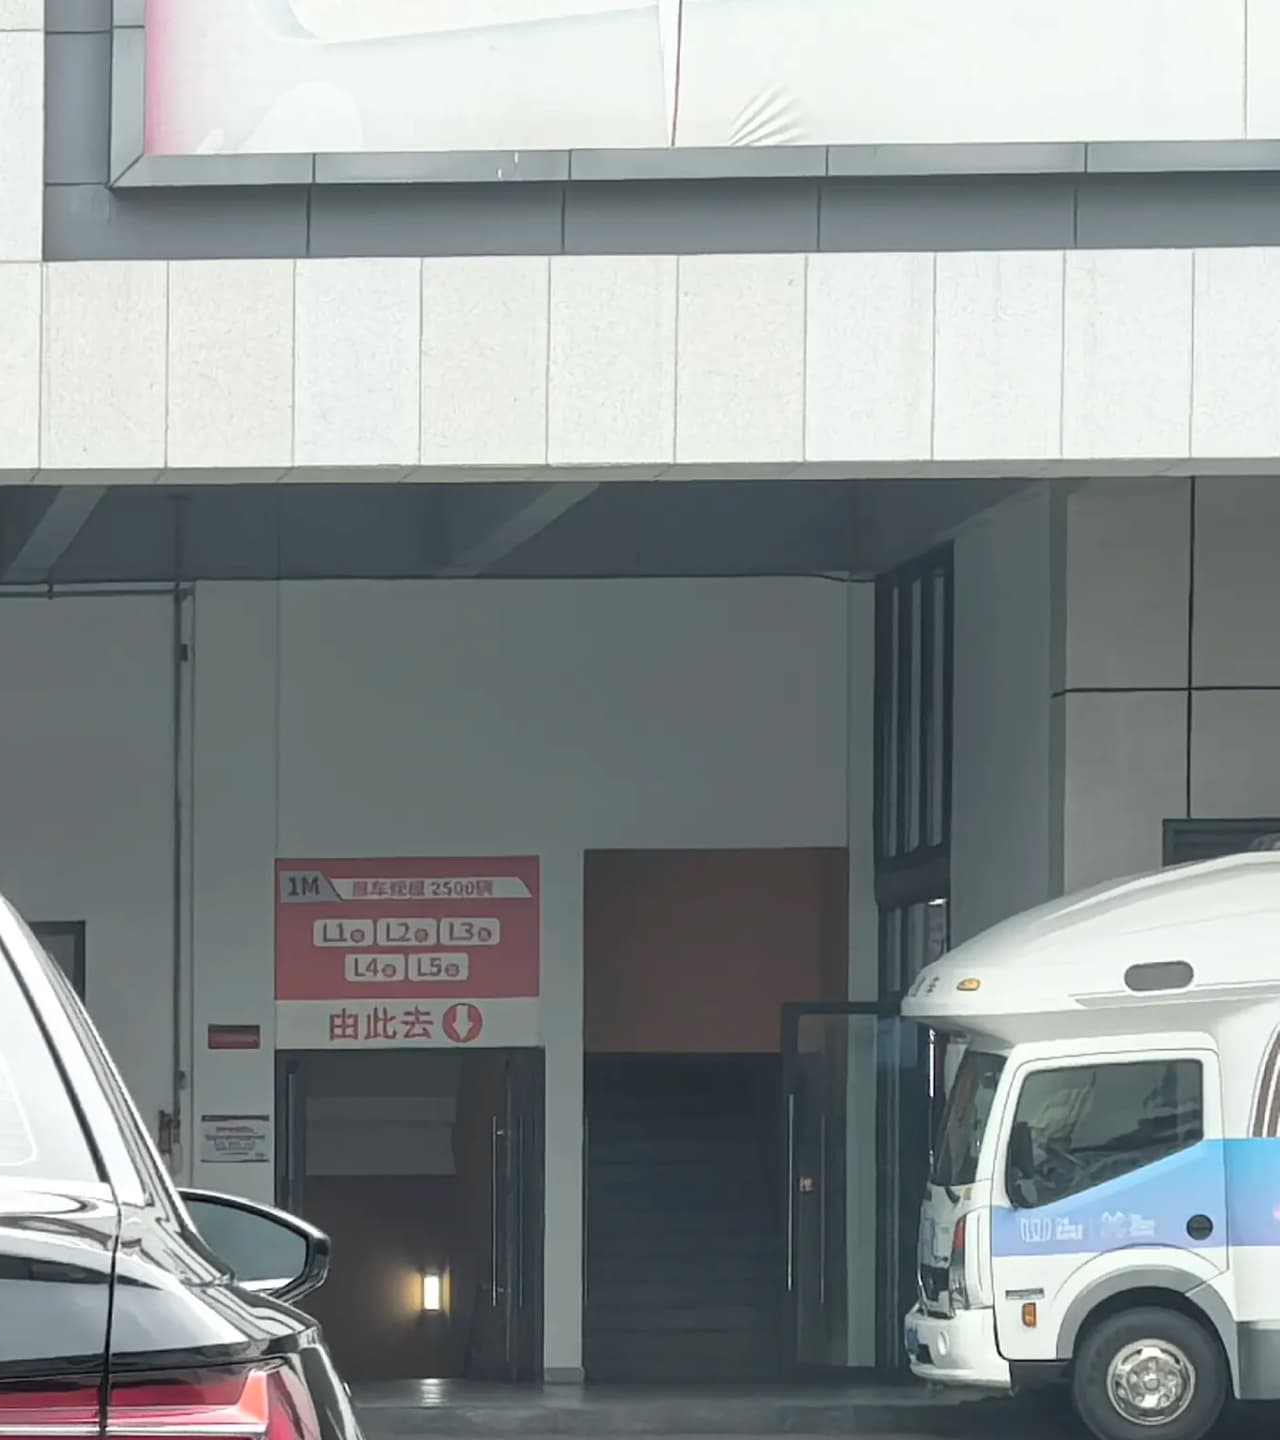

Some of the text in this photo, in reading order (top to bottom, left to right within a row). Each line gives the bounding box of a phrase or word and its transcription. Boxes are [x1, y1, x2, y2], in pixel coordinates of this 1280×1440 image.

[287, 876, 320, 897] 1M
[329, 1005, 434, 1040] 由此去
